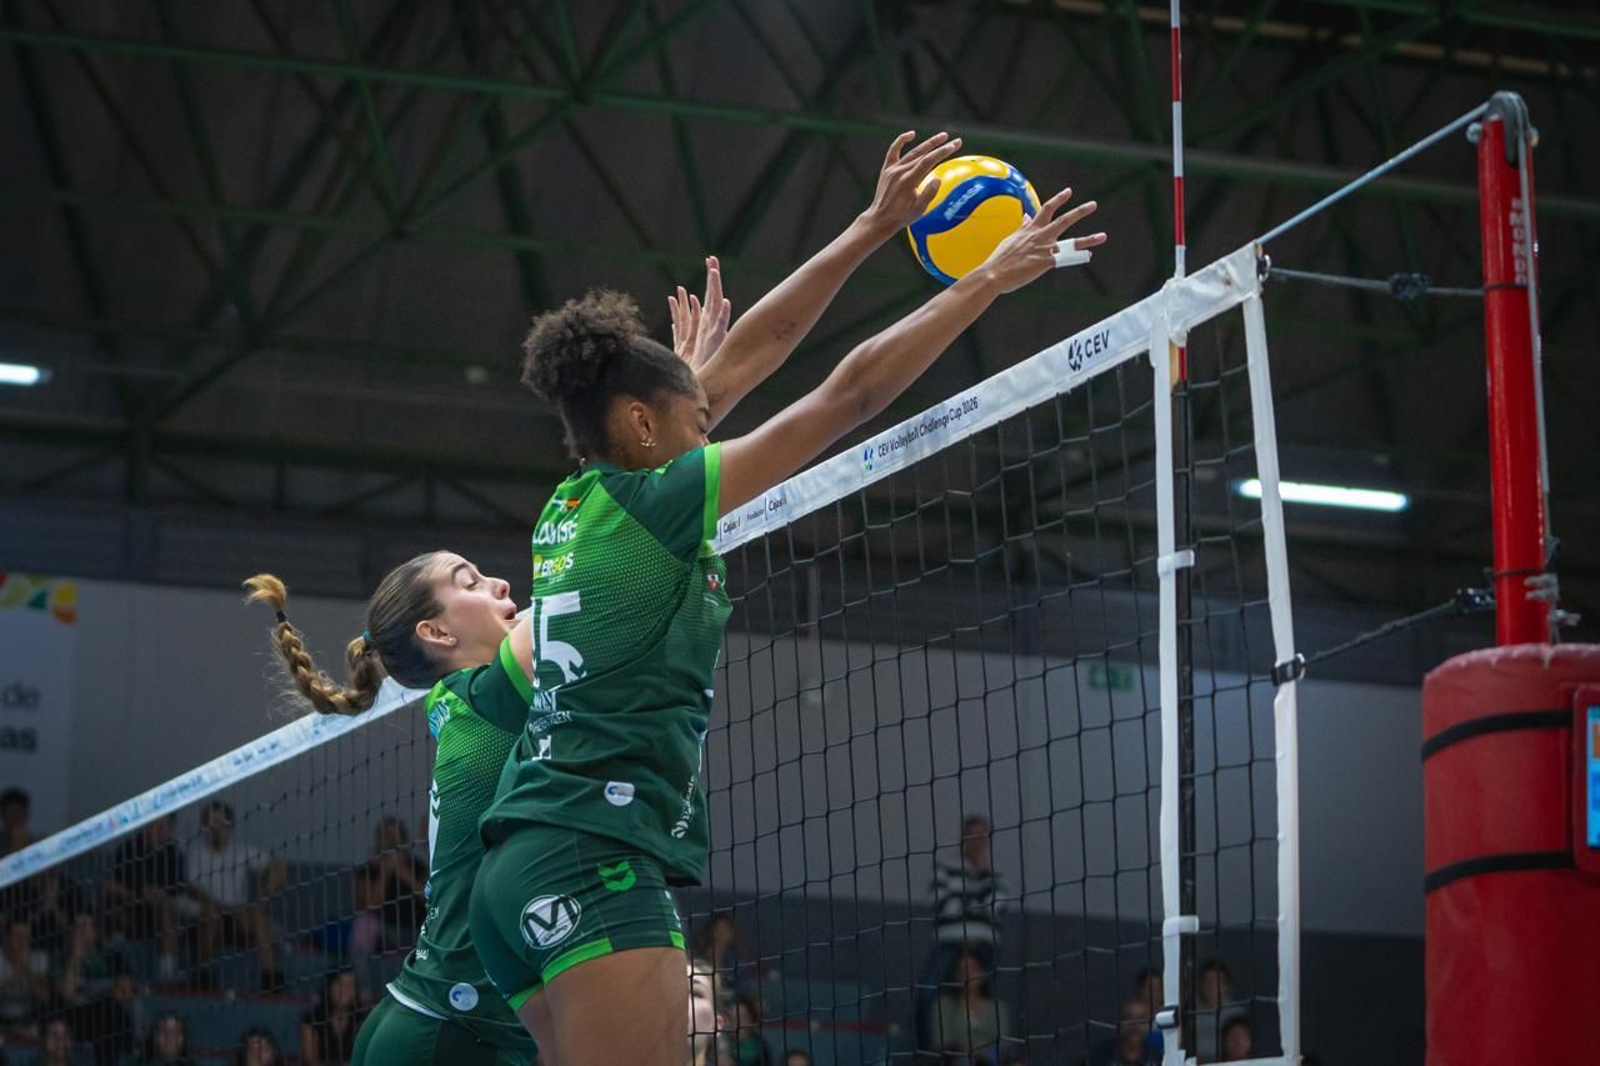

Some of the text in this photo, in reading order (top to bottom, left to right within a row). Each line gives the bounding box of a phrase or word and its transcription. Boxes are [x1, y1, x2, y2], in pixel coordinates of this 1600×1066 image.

[1085, 329, 1109, 358] CEV
[878, 396, 979, 458] CEV Volleyball Challenge Cup 2026
